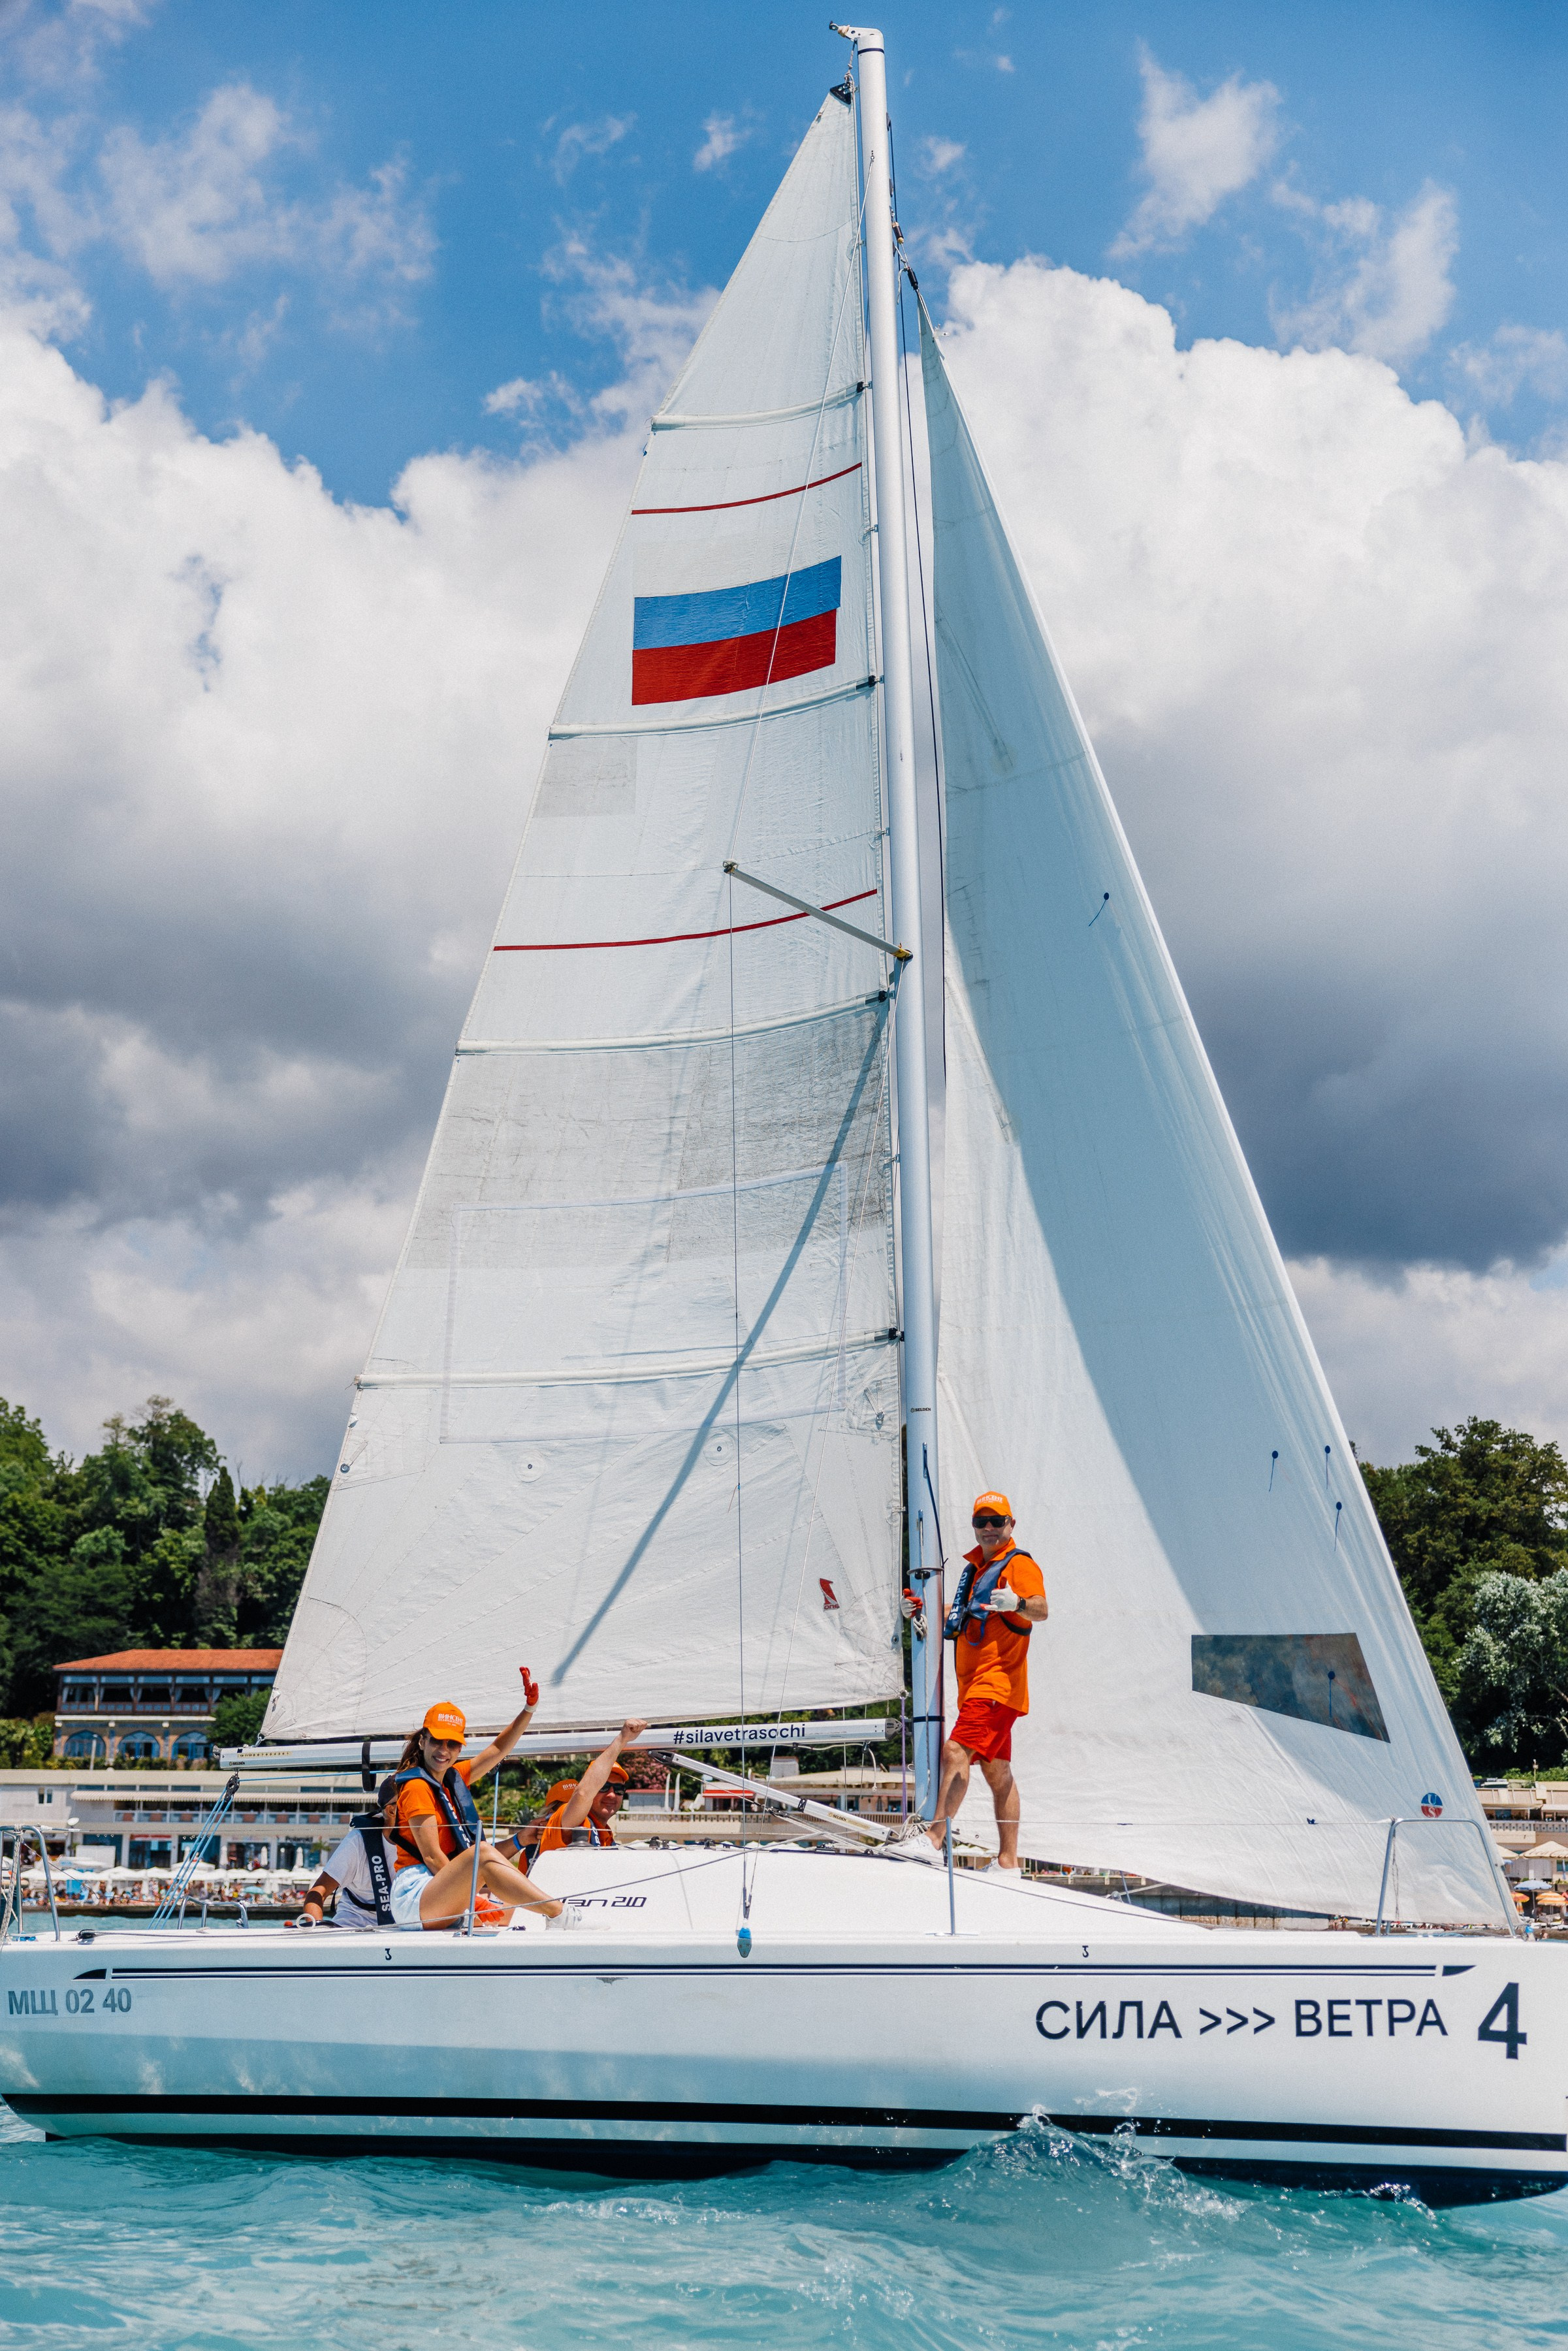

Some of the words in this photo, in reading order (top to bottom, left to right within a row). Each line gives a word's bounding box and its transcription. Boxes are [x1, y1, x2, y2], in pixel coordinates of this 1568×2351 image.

[949, 1572, 967, 1620] SEA-PRO
[438, 1713, 463, 1723] ВИНСЕНТ
[673, 1724, 805, 1744] #silavetrasochi
[372, 1855, 391, 1911] SEA-PRO
[611, 1896, 647, 1907] 210
[8, 1990, 58, 2015] МЩ
[66, 1989, 95, 2013] 02
[103, 1988, 131, 2013] 40
[1035, 2000, 1183, 2040] СИЛА
[1294, 1998, 1448, 2038] ВЕТРА
[1477, 1982, 1528, 2060] 4
